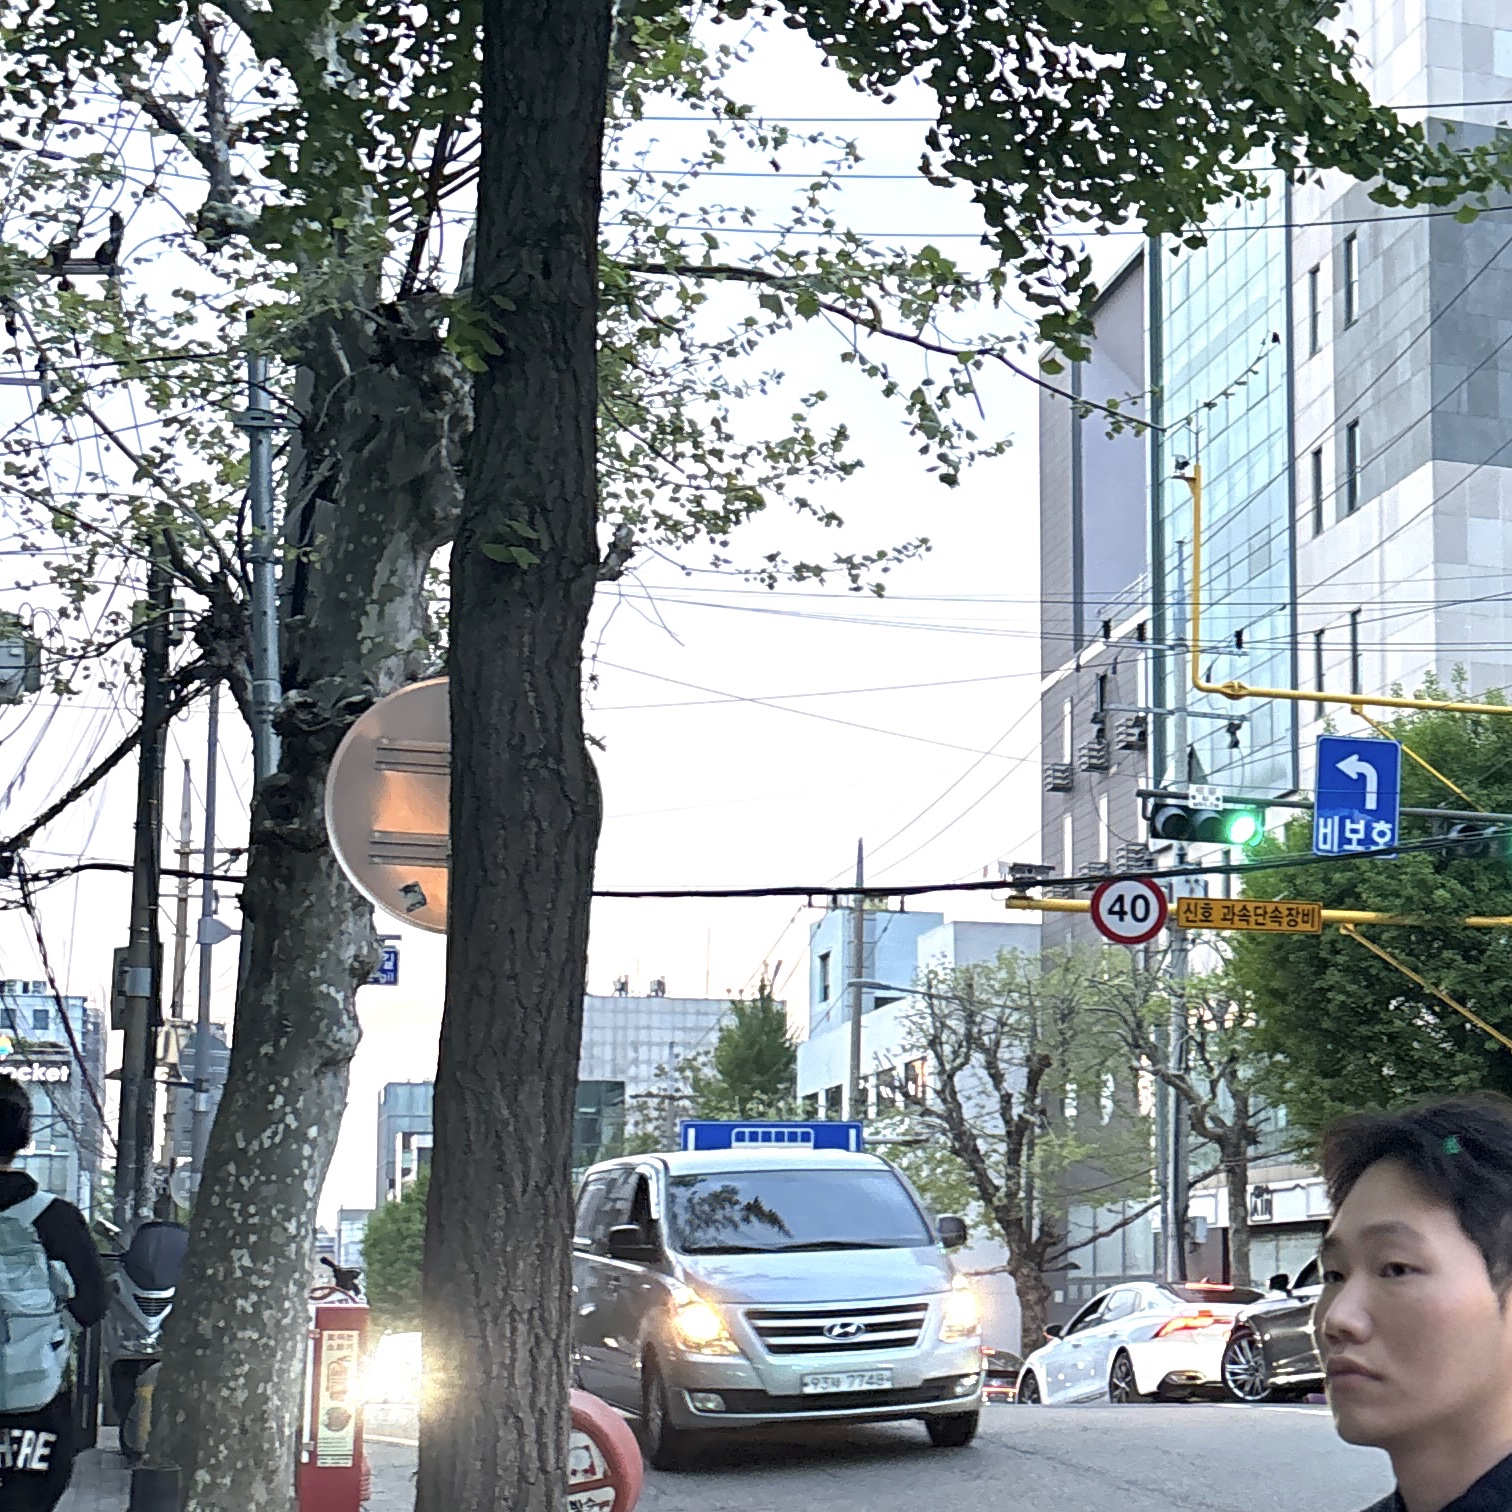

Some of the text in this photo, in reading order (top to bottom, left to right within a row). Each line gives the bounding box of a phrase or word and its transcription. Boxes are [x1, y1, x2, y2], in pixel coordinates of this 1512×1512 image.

[1318, 815, 1393, 853] 비보호
[1107, 893, 1151, 923] 40
[1183, 902, 1316, 929] 신호 과속단속장비
